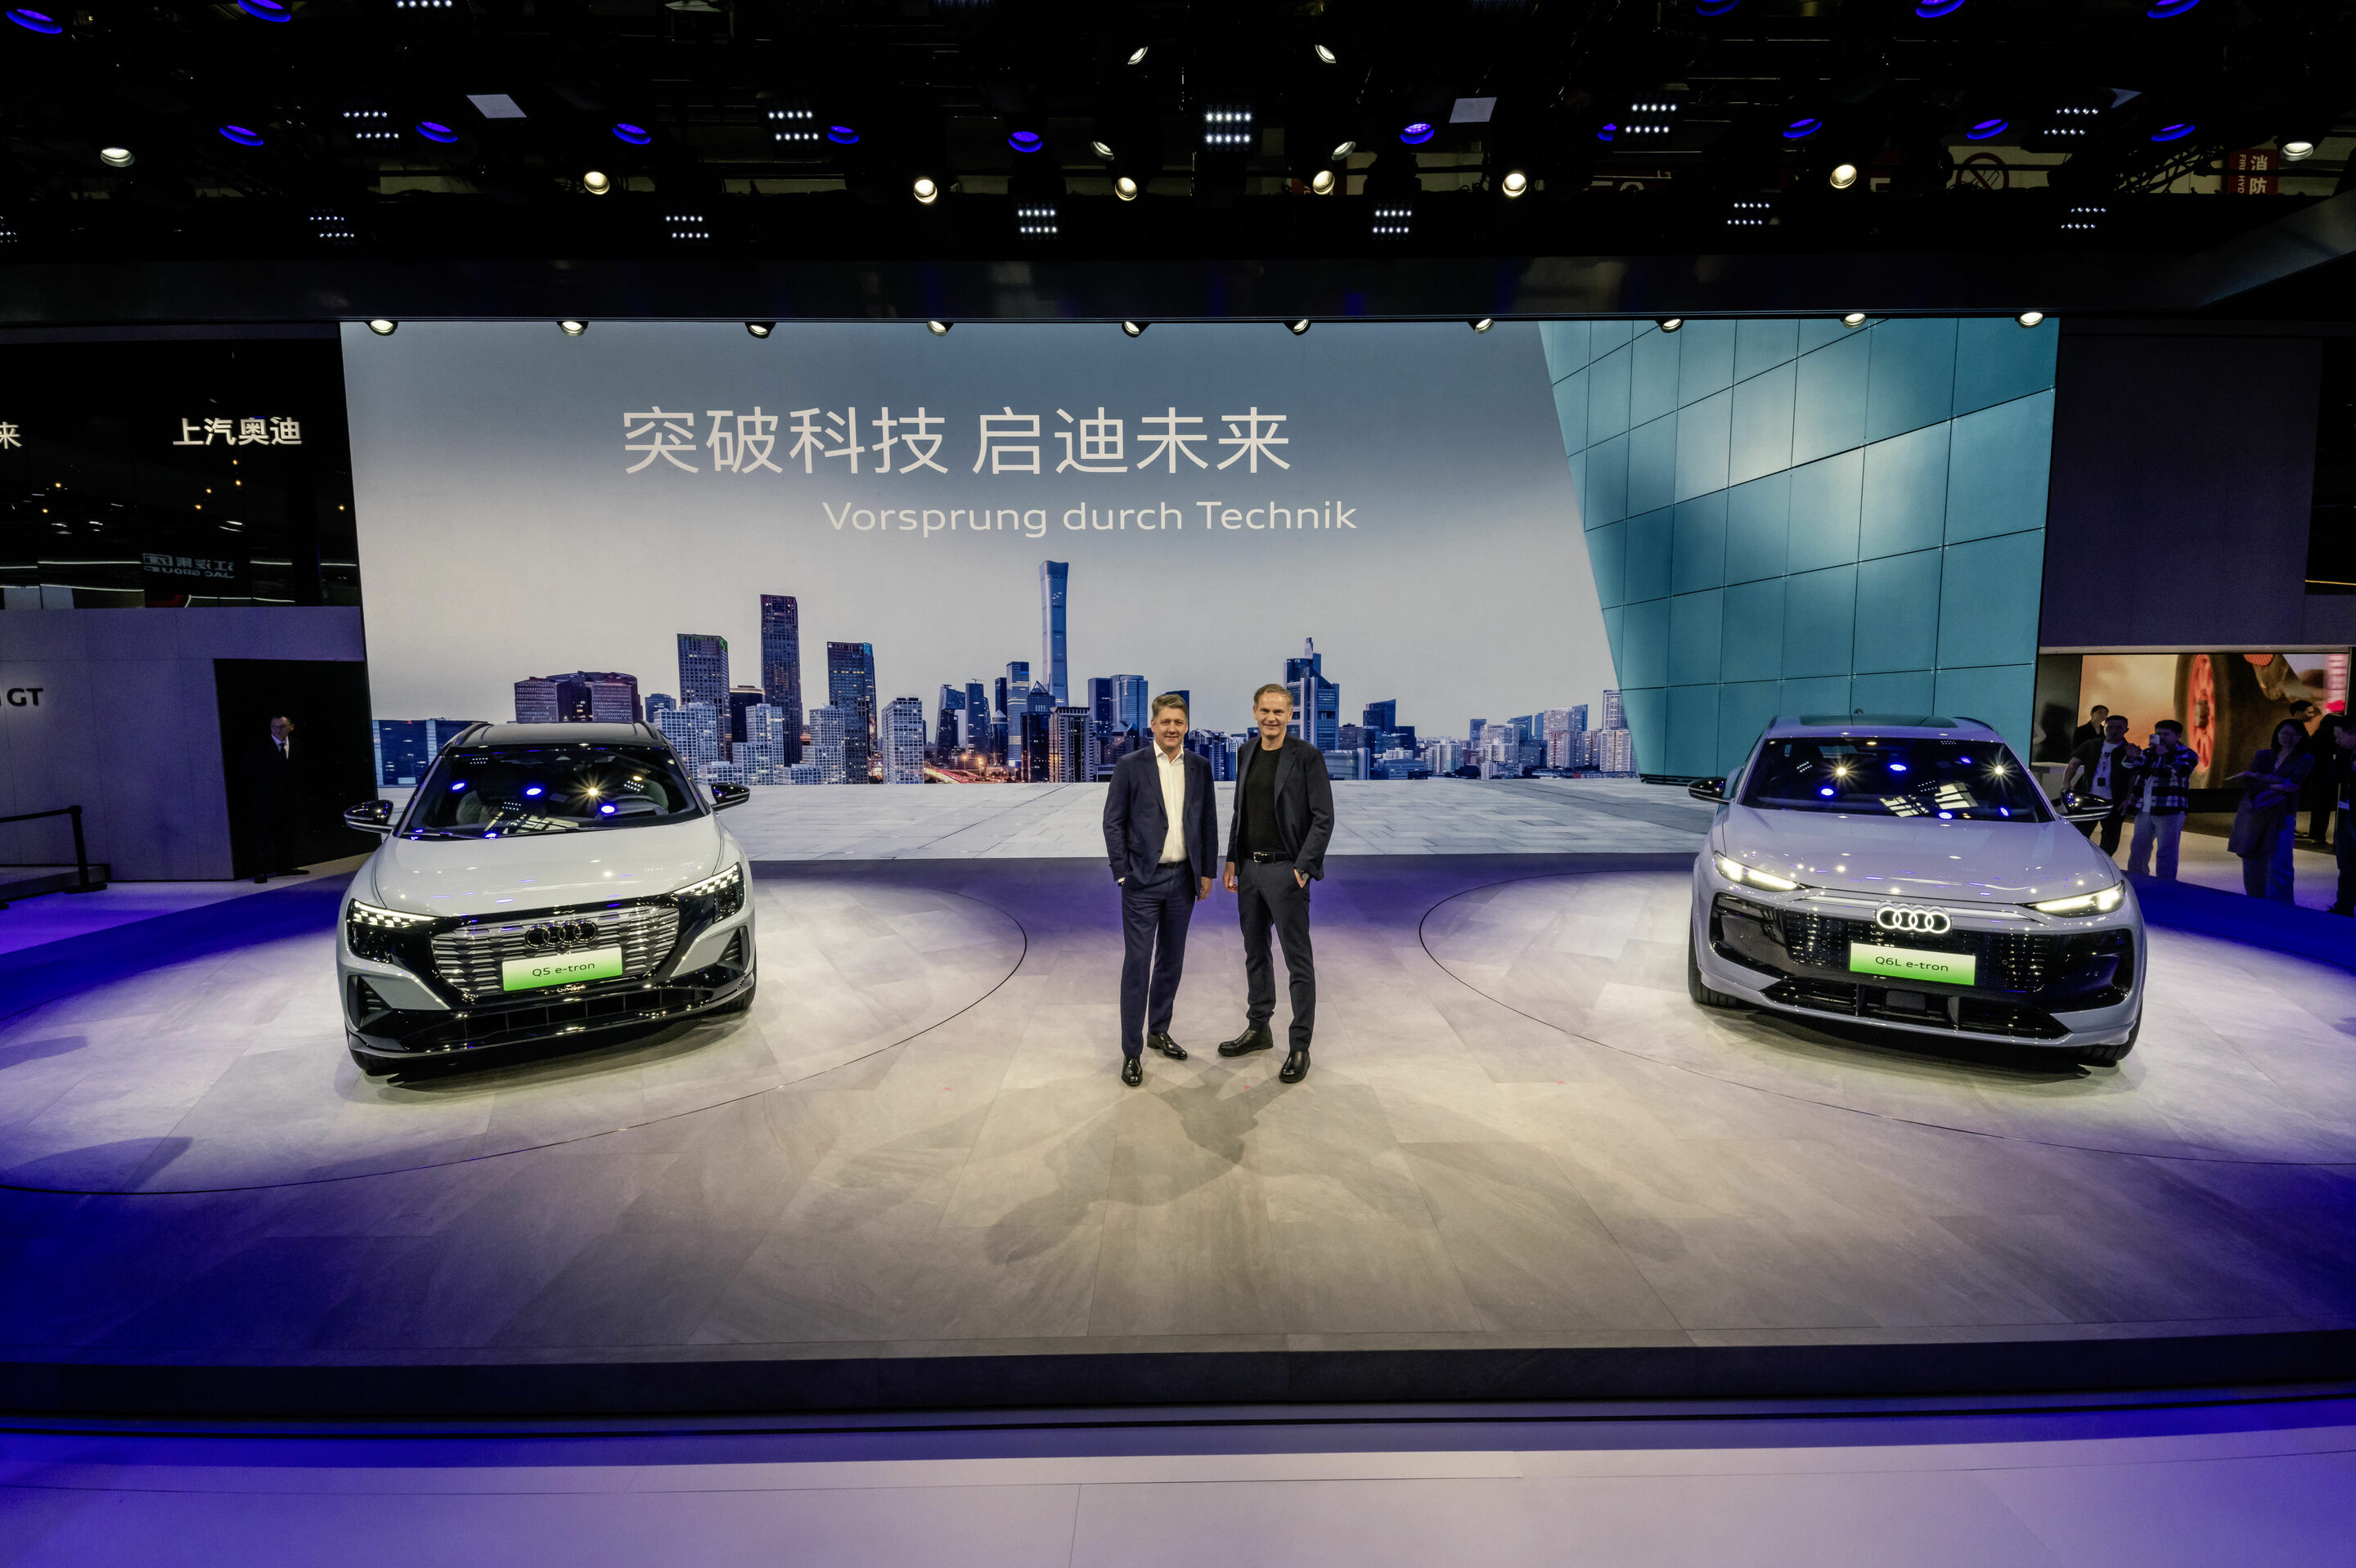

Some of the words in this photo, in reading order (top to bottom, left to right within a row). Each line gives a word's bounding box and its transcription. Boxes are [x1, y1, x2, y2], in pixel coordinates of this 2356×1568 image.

[2249, 154, 2268, 195] 消防
[173, 416, 303, 446] 上汽奥迪
[623, 406, 949, 474] 突破科技
[973, 406, 1291, 474] 启迪未来
[822, 501, 1047, 538] Vorsprung
[1063, 501, 1183, 531] durch
[1196, 501, 1358, 530] Technik
[7, 688, 44, 707] GT
[533, 967, 551, 977] Q5
[555, 963, 596, 974] e-tron
[1875, 956, 1902, 967] Q6L
[1906, 960, 1949, 972] e-tron
